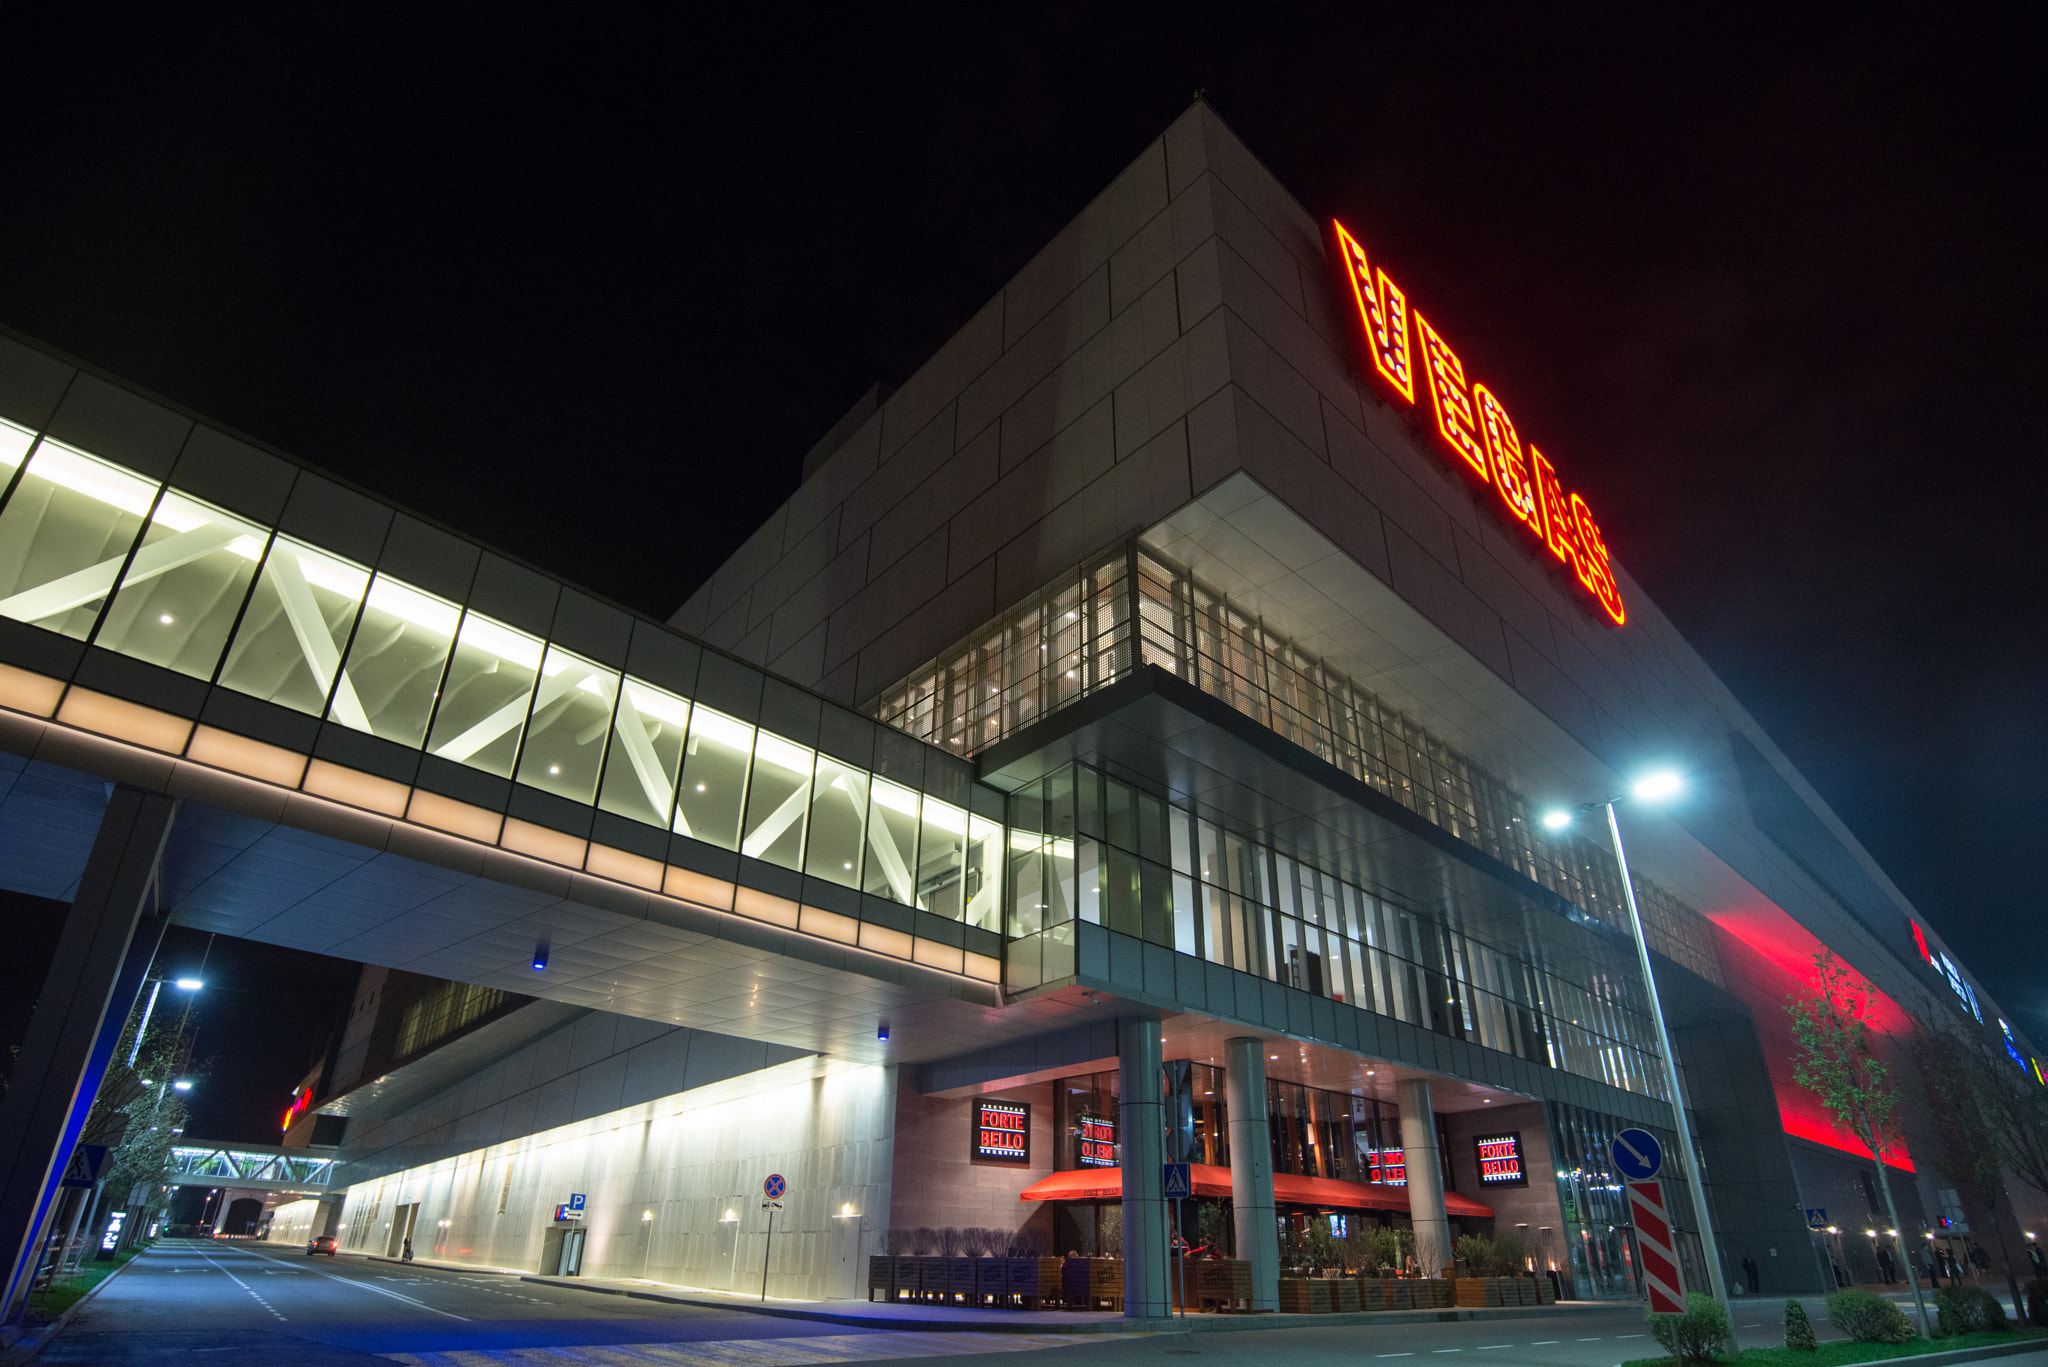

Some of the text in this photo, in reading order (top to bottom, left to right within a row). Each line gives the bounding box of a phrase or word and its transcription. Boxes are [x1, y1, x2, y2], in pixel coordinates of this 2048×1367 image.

[1333, 218, 1625, 626] VEGAS
[981, 1111, 1024, 1130] FORTE
[981, 1131, 1024, 1149] BELLO
[1479, 1142, 1517, 1158] FORTE
[1482, 1159, 1519, 1175] BELLO
[573, 1195, 584, 1209] P
